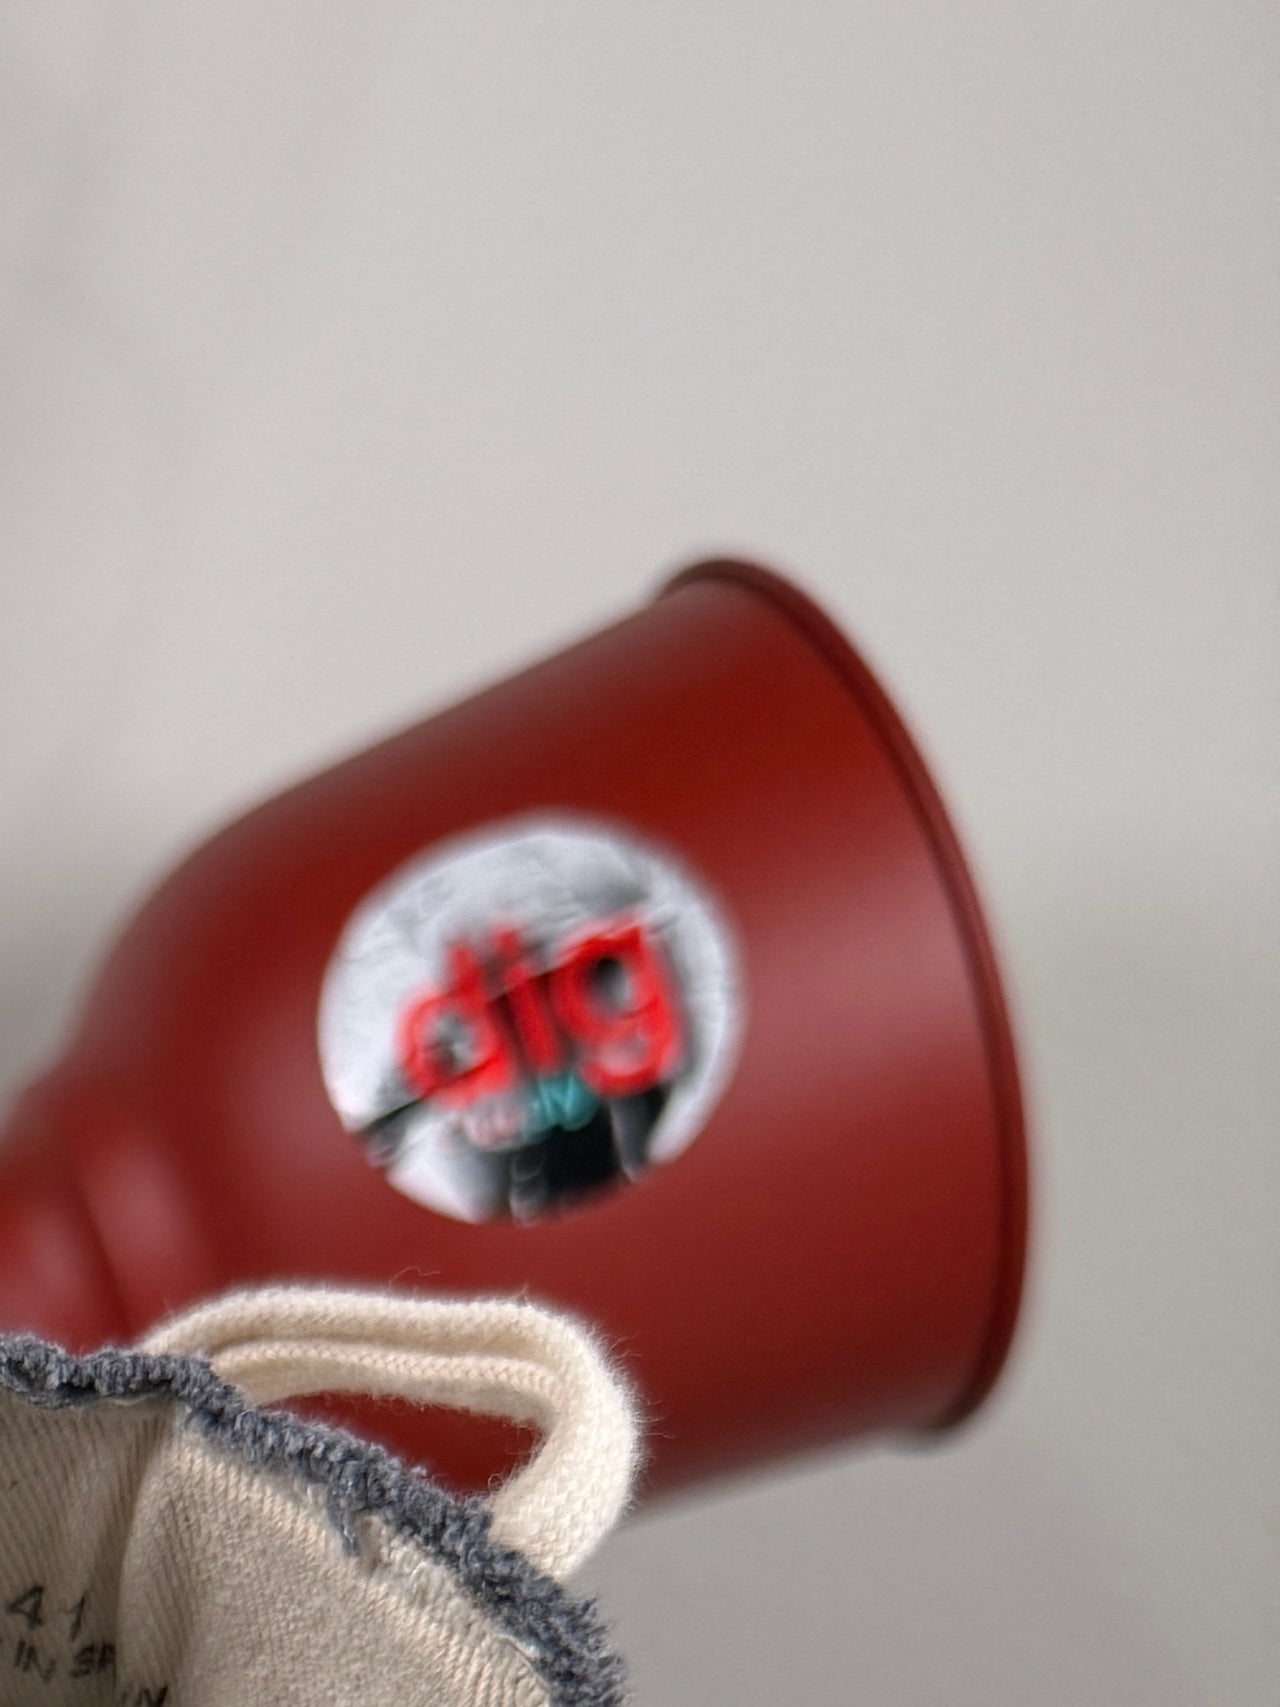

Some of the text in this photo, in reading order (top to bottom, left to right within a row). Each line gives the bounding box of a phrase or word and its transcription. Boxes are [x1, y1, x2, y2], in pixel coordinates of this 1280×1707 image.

[394, 915, 684, 1106] dig
[4, 1584, 88, 1643] 41
[12, 1639, 57, 1684] IN
